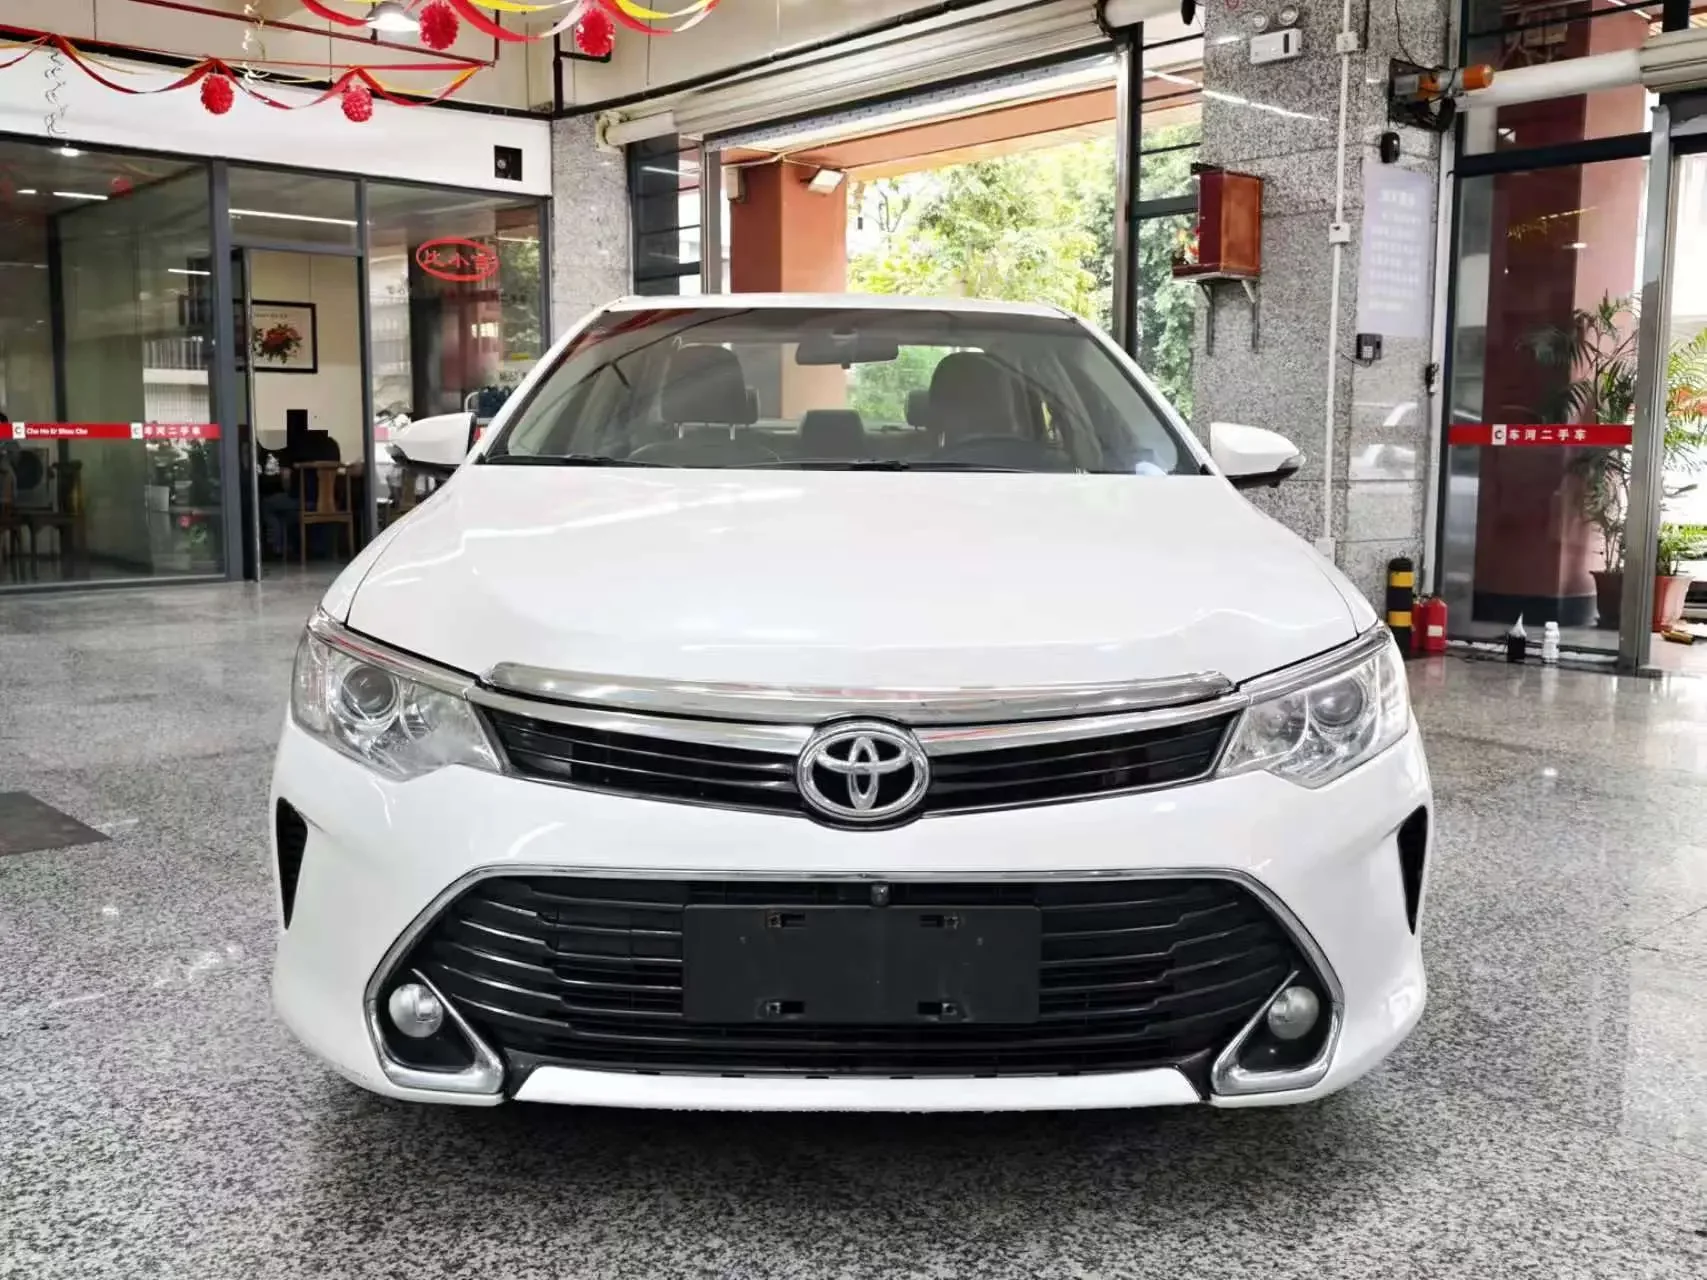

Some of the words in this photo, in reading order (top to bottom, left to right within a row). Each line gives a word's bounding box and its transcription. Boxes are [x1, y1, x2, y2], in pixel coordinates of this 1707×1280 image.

[1509, 428, 1587, 441] 车河二手车
